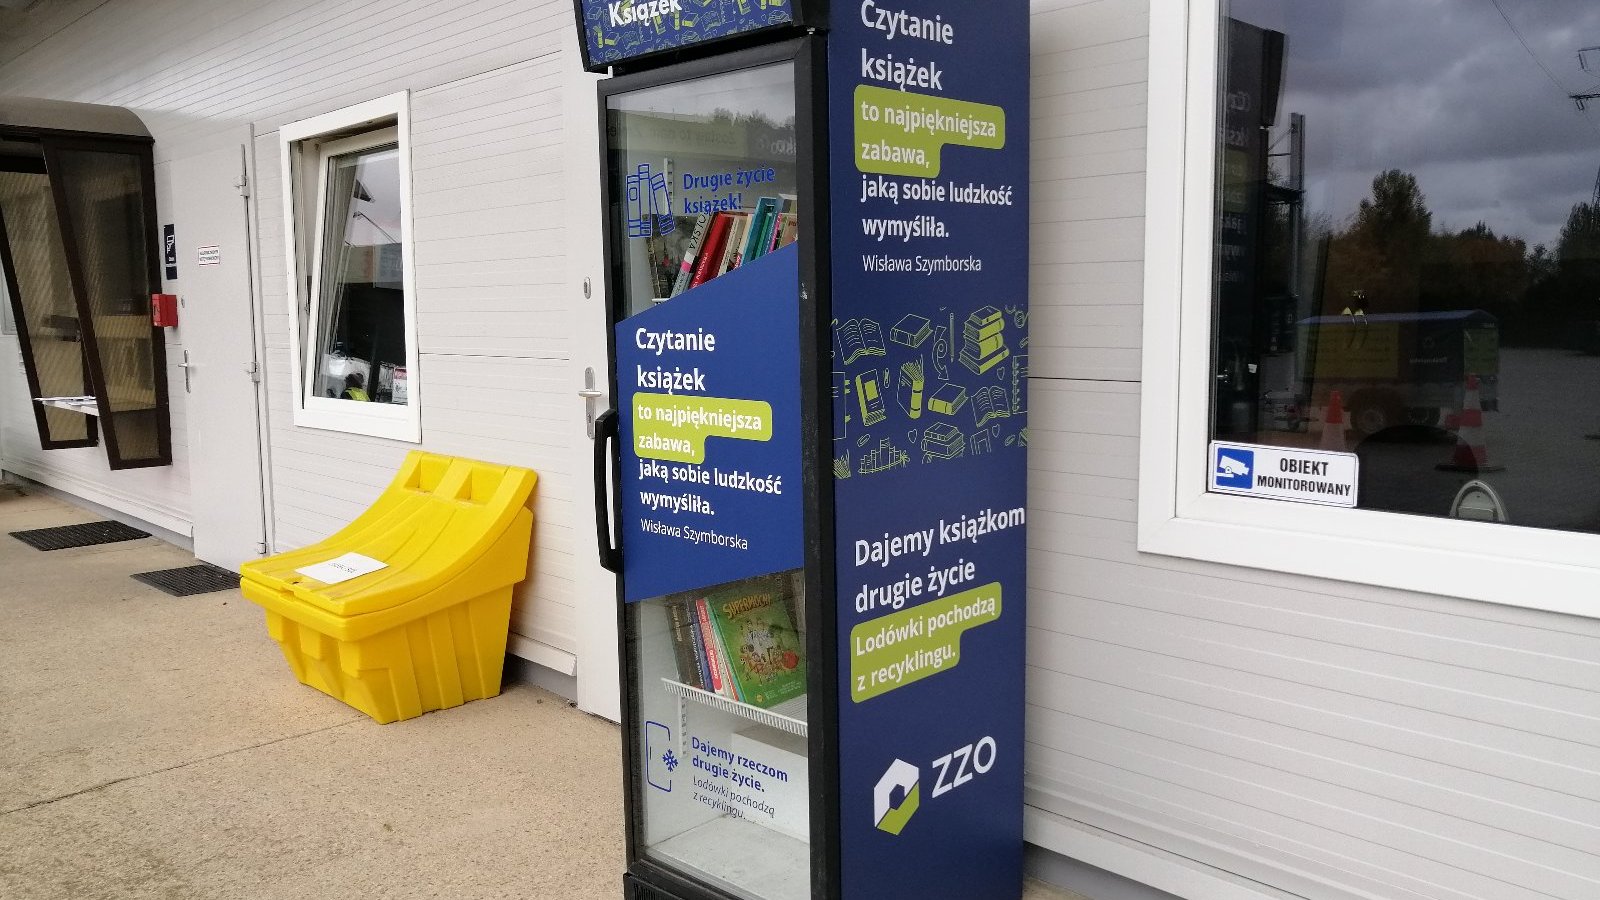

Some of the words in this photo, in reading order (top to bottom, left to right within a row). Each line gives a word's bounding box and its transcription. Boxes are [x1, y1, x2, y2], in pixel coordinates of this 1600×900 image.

[861, 0, 954, 44] Czytanie
[861, 48, 943, 92] książek
[861, 101, 880, 122] to
[885, 105, 996, 140] najpiękniejsza
[861, 139, 930, 168] zabawa,
[683, 172, 732, 192] Drugie
[737, 165, 776, 188] życie
[860, 174, 899, 204] jaką
[902, 178, 946, 201] sobie
[949, 181, 1013, 206] ludzkość
[684, 193, 742, 216] książek!
[862, 215, 949, 242] wymyśliła.
[862, 254, 912, 272] Wisława
[915, 255, 982, 275] Szymborska
[635, 327, 716, 355] Czytanie
[637, 364, 706, 395] książek
[638, 404, 652, 420] to
[656, 405, 762, 432] najpiękniejsza
[638, 432, 695, 457] zabawa,
[638, 459, 669, 483] jaką
[672, 463, 710, 485] sobie
[714, 467, 782, 495] ludzkość
[1279, 457, 1329, 476] OBIEKT
[1257, 475, 1351, 497] MONITOROWANY
[640, 490, 715, 516] wymyśliła.
[640, 518, 681, 538] Wisława
[683, 525, 748, 550] Szymborska
[855, 528, 935, 567] Dajemy
[939, 506, 1025, 545] książkom
[855, 572, 923, 613] drugie
[927, 558, 976, 597] życie
[856, 615, 923, 656] Lodówki
[927, 597, 996, 638] pochodzą
[857, 673, 866, 692] z
[871, 643, 956, 687] recyklingu.
[691, 736, 735, 765] Dajemy
[737, 755, 788, 783] rzeczom
[692, 755, 729, 778] drugie
[731, 768, 765, 793] życie.
[931, 735, 997, 799] ZZO
[693, 775, 729, 798] Lodówki
[730, 790, 775, 819] pochodzą
[693, 790, 698, 801] z
[699, 791, 746, 820] recyklingu.
